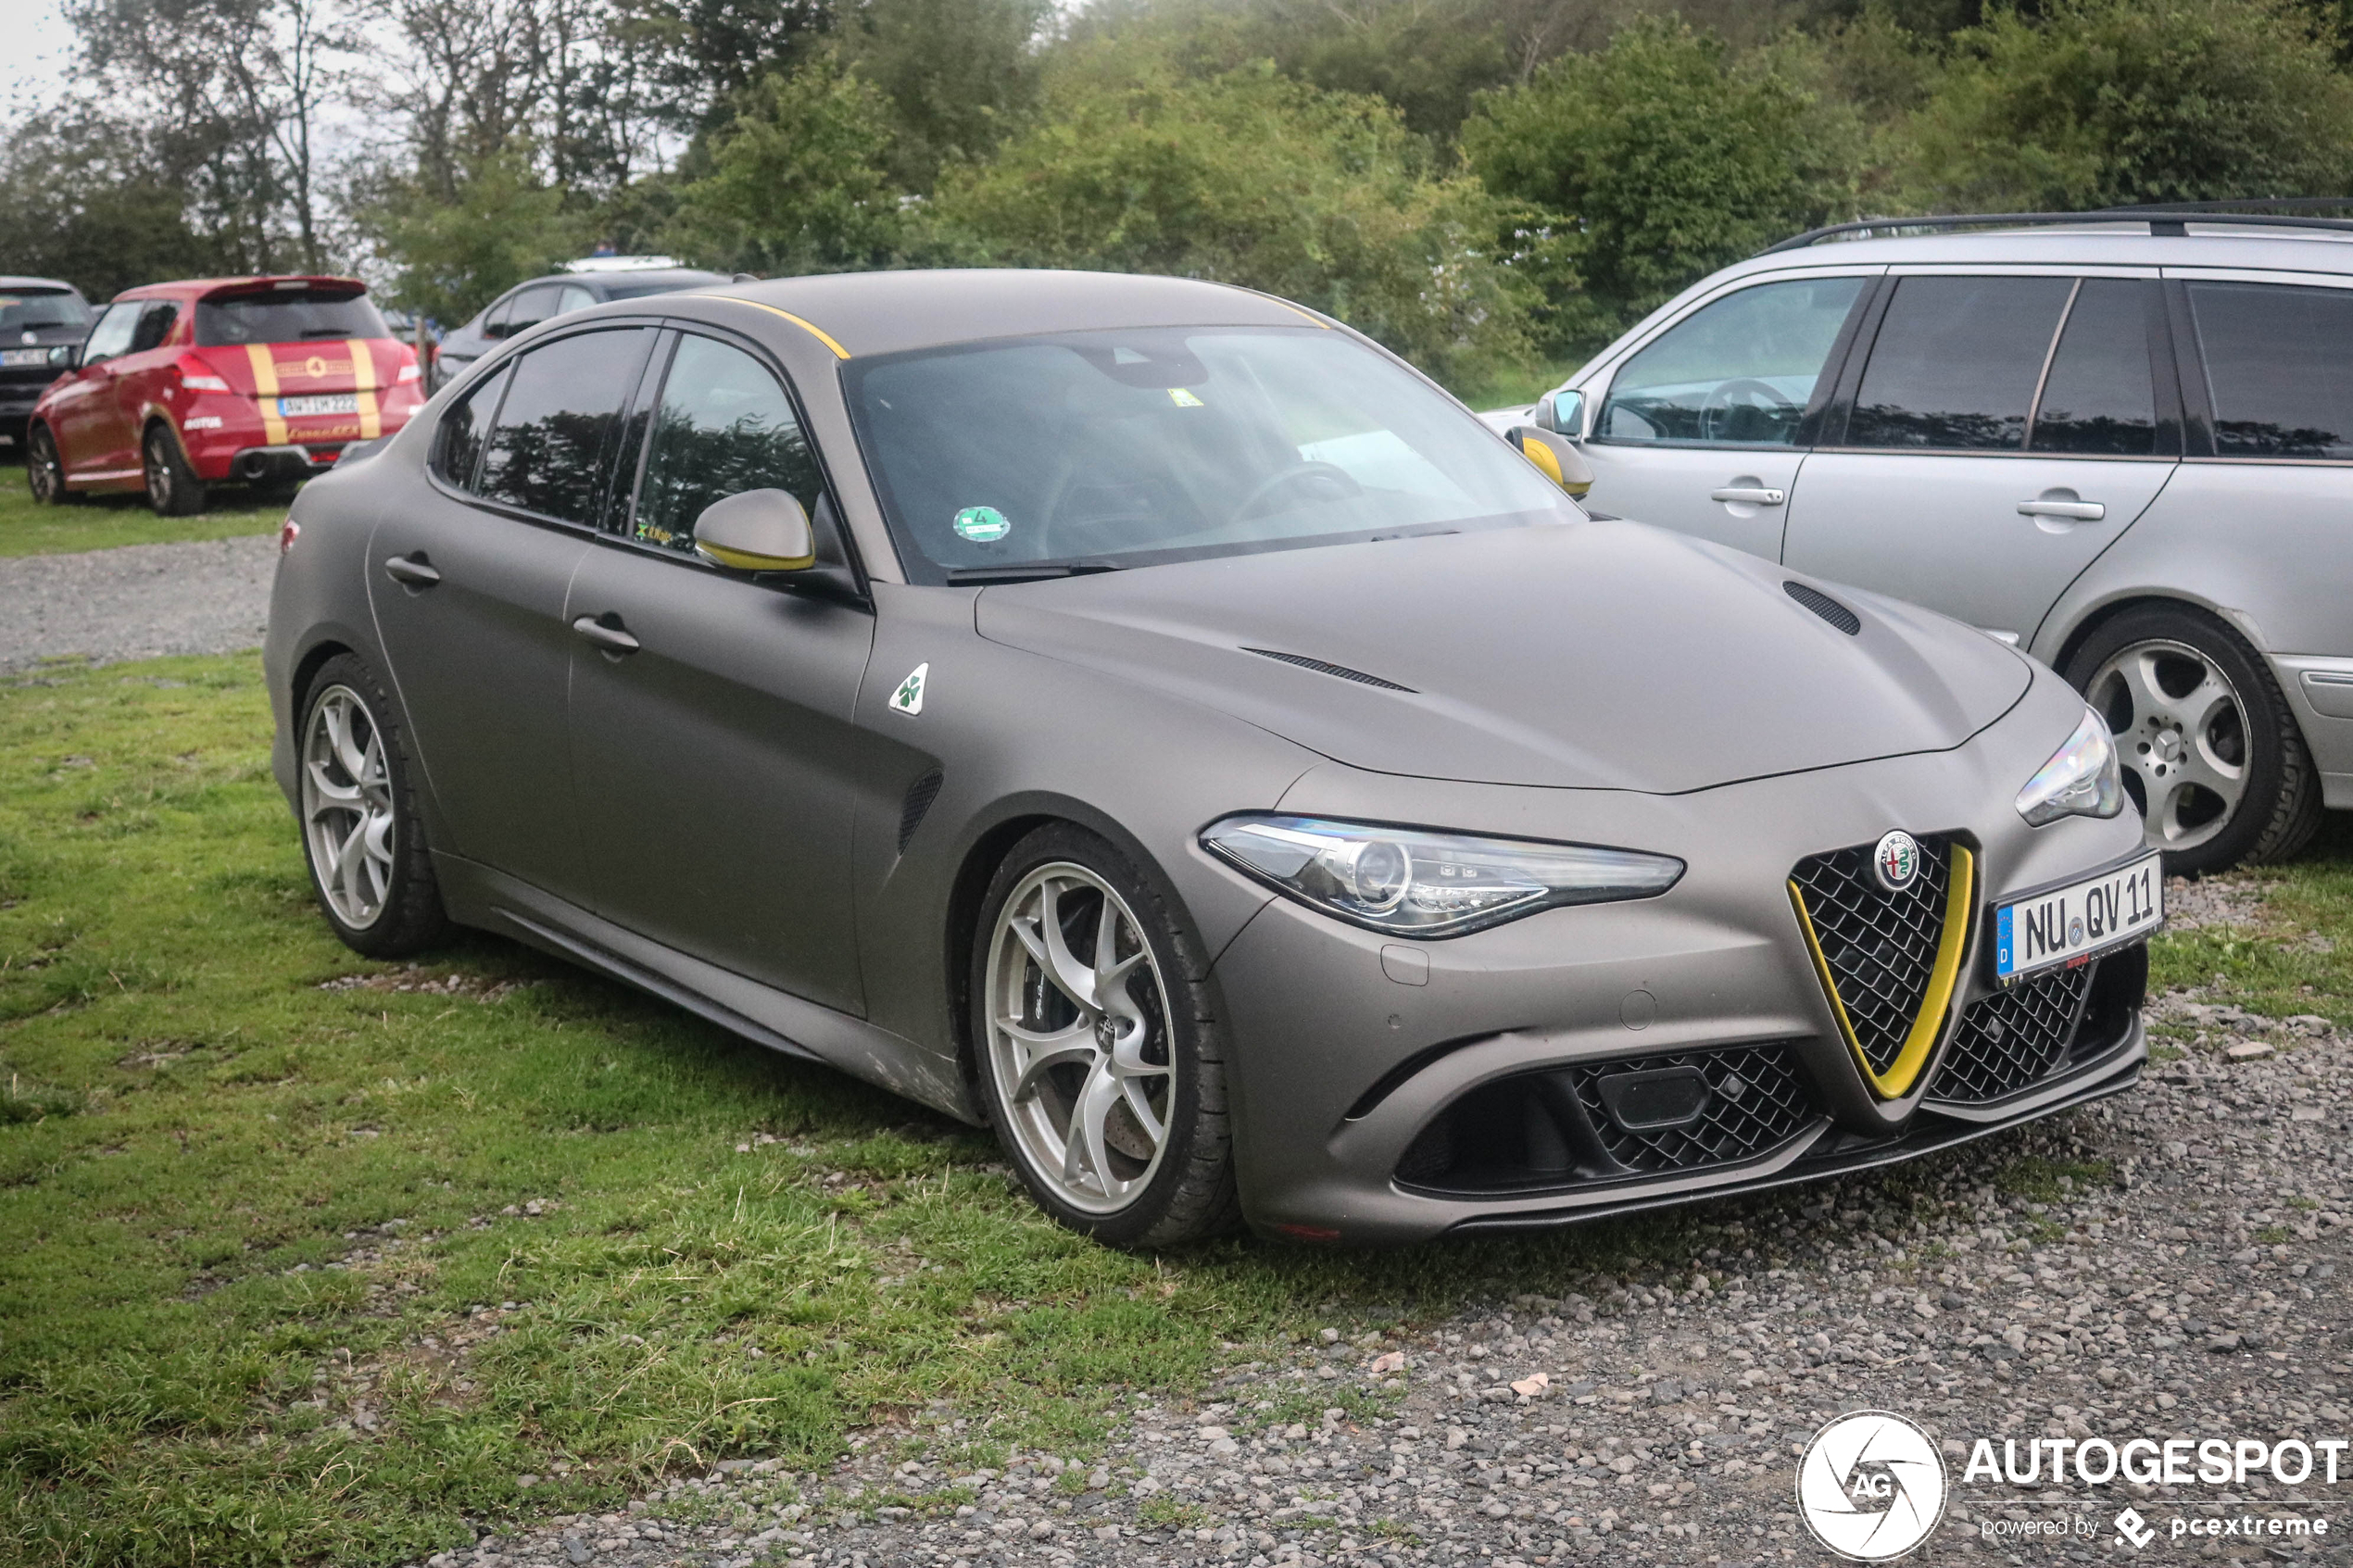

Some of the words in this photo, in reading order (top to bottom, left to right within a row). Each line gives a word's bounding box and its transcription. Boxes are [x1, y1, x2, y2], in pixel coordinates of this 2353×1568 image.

[333, 395, 357, 410] 222
[974, 510, 988, 524] 4
[1881, 840, 1893, 864] ALFA
[1894, 837, 1917, 860] ROMEO
[2026, 897, 2066, 960] NU
[2086, 879, 2120, 938] QV
[2126, 867, 2153, 926] 11
[2000, 947, 2007, 964] D
